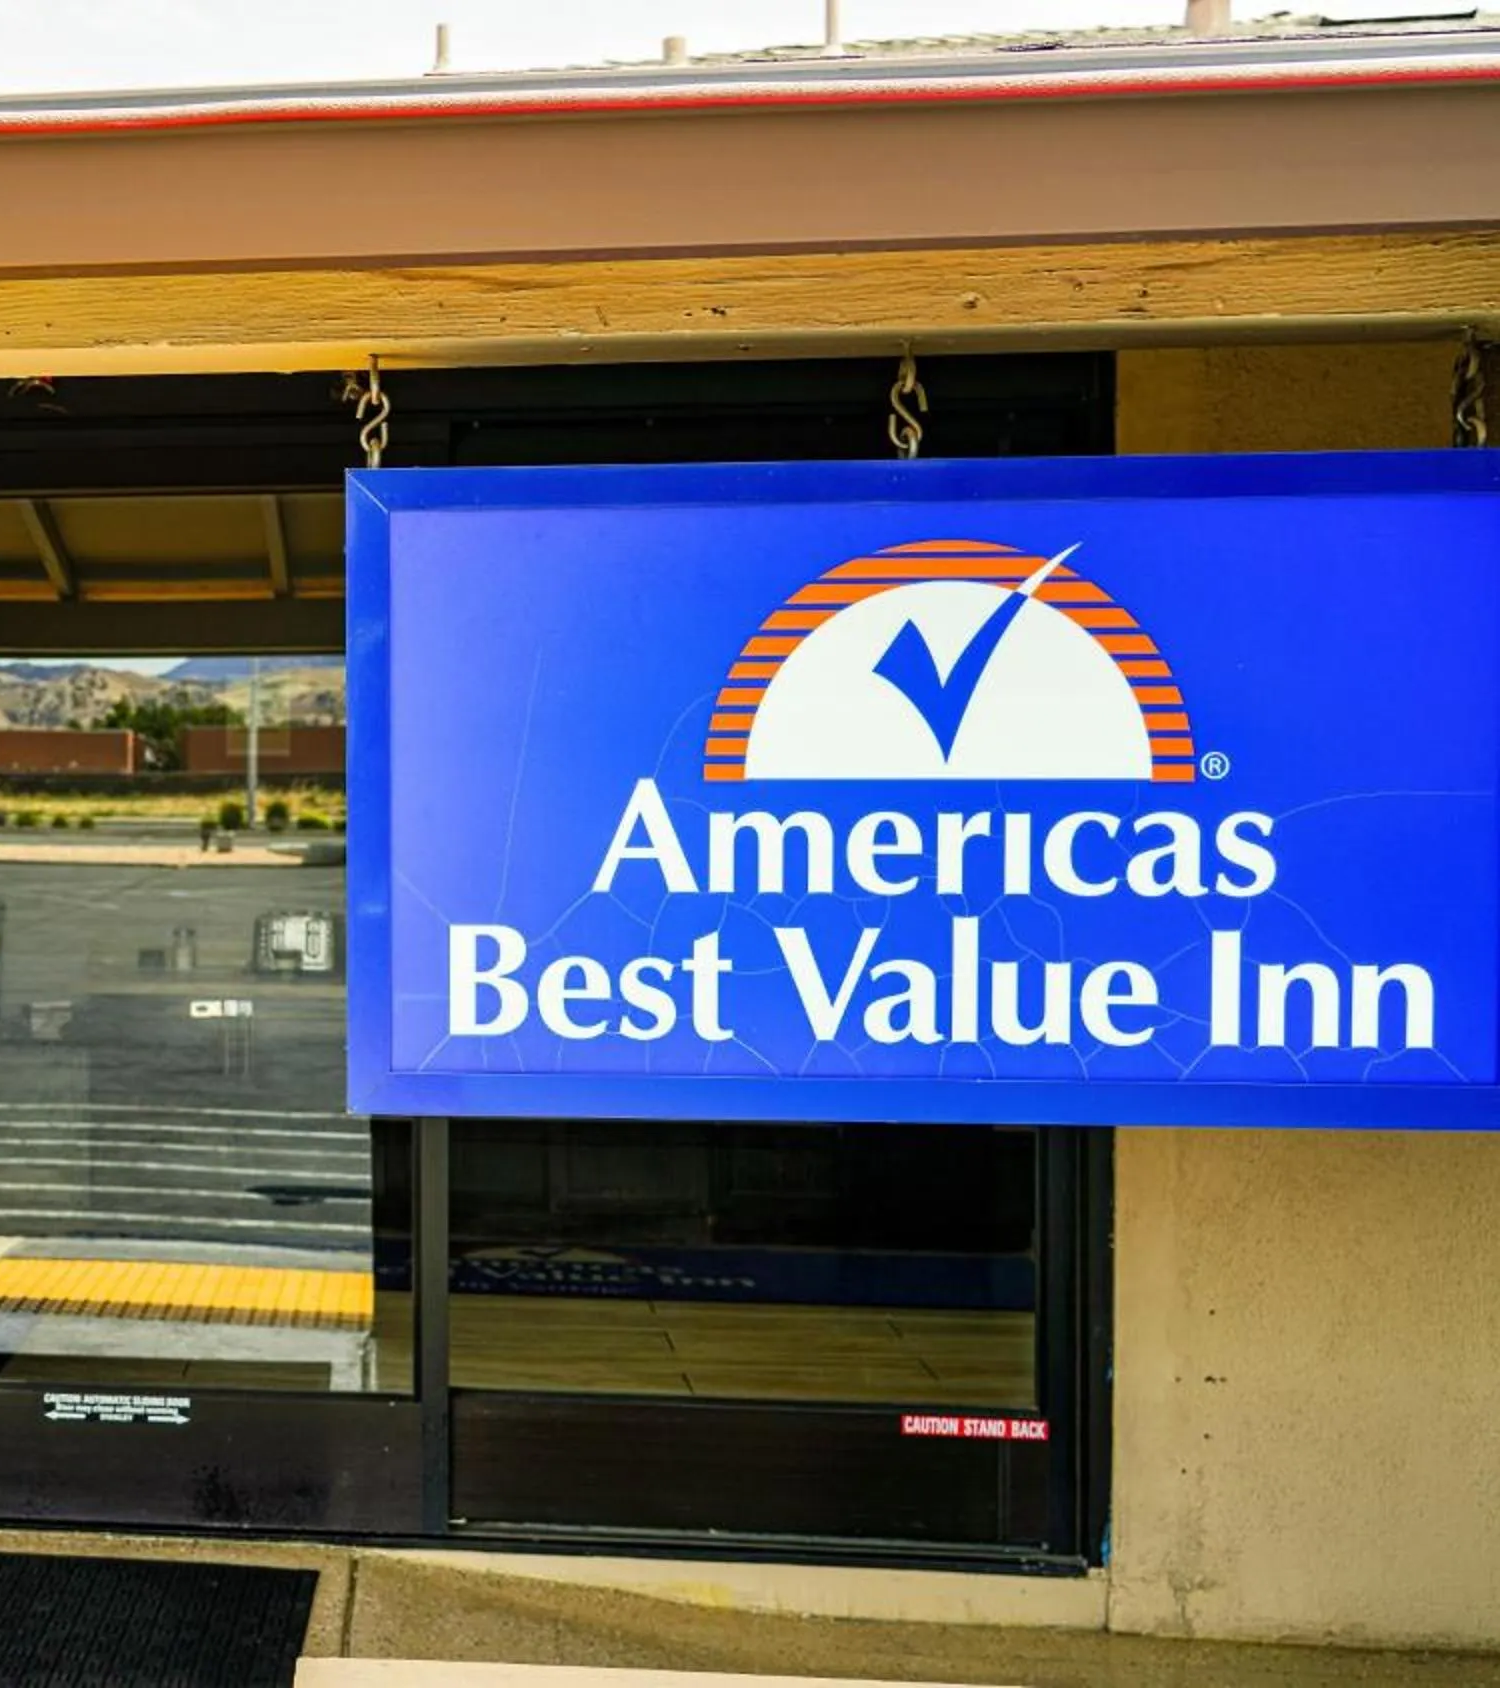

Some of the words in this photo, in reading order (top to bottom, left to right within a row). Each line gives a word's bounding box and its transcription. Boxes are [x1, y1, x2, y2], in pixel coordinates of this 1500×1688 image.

[592, 777, 1277, 897] Americas
[448, 923, 733, 1042] Best
[773, 916, 1159, 1047] Value
[1210, 930, 1434, 1049] Inn
[903, 1415, 959, 1436] CAUTION
[963, 1418, 1007, 1438] STAND
[1010, 1419, 1046, 1439] BACK
